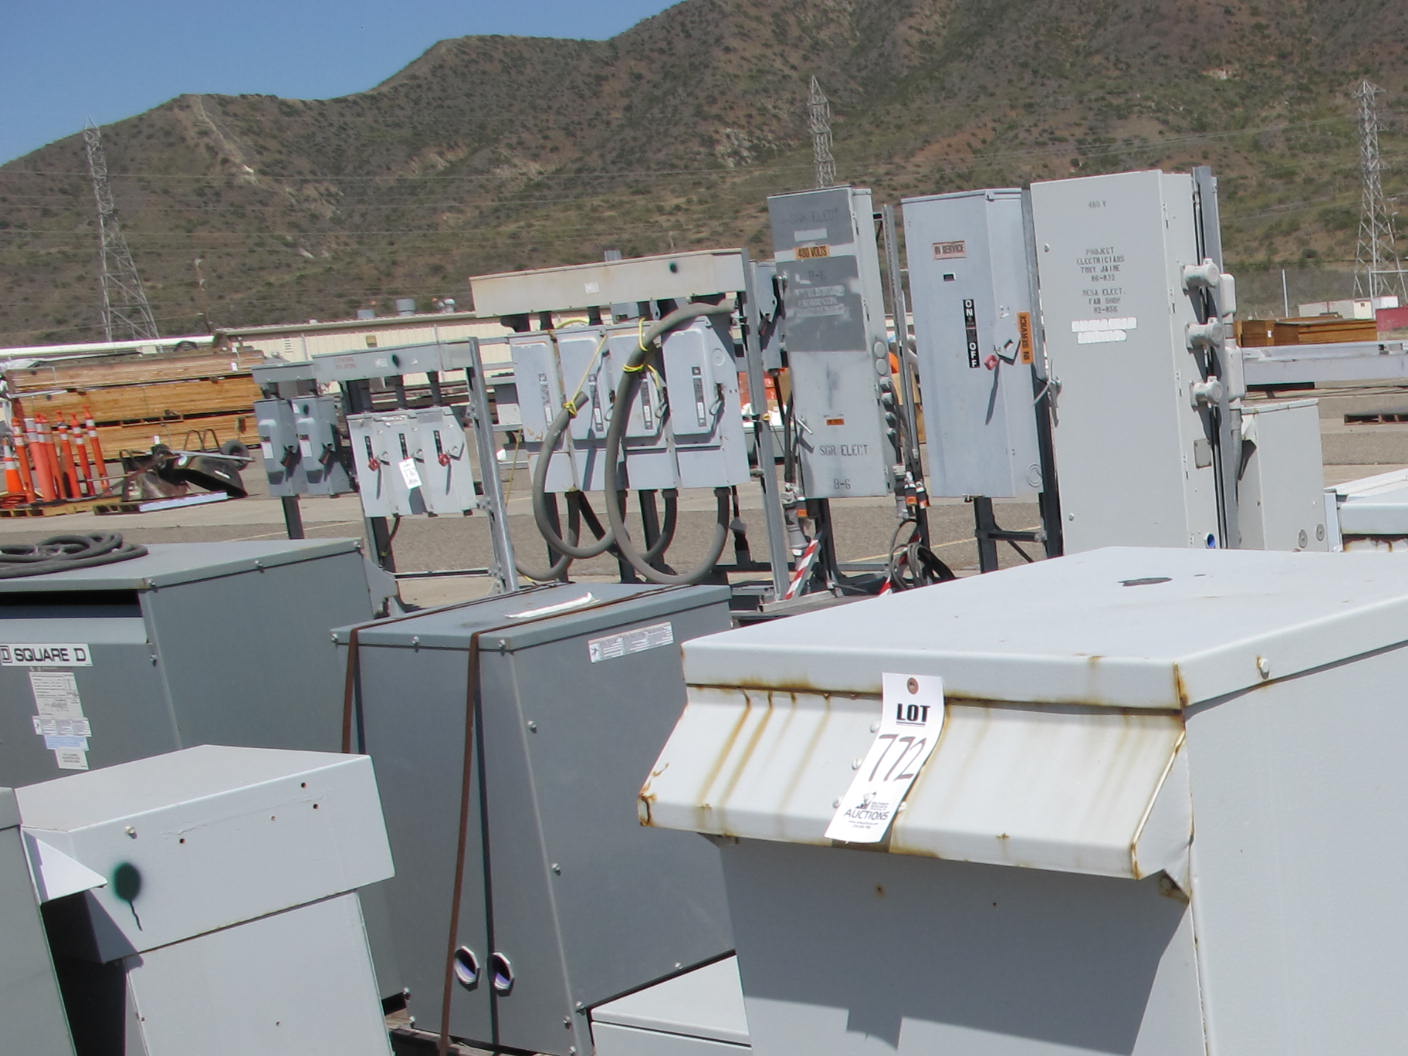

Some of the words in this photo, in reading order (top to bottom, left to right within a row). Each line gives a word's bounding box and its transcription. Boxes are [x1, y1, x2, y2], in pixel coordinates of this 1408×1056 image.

[797, 247, 809, 258] 480
[810, 245, 828, 257] VOLTS
[942, 243, 964, 255] SERVICE
[1086, 247, 1115, 256] PROJECT
[964, 300, 974, 317] ON
[1020, 315, 1030, 348] SERVICE
[969, 342, 978, 368] OFF
[1023, 350, 1031, 360] IN
[840, 444, 868, 457] ELECT
[14, 648, 70, 662] SQUARE
[74, 647, 87, 662] D
[896, 703, 930, 723] LOT
[869, 733, 927, 782] 772
[844, 808, 890, 822] AUCTIONS
